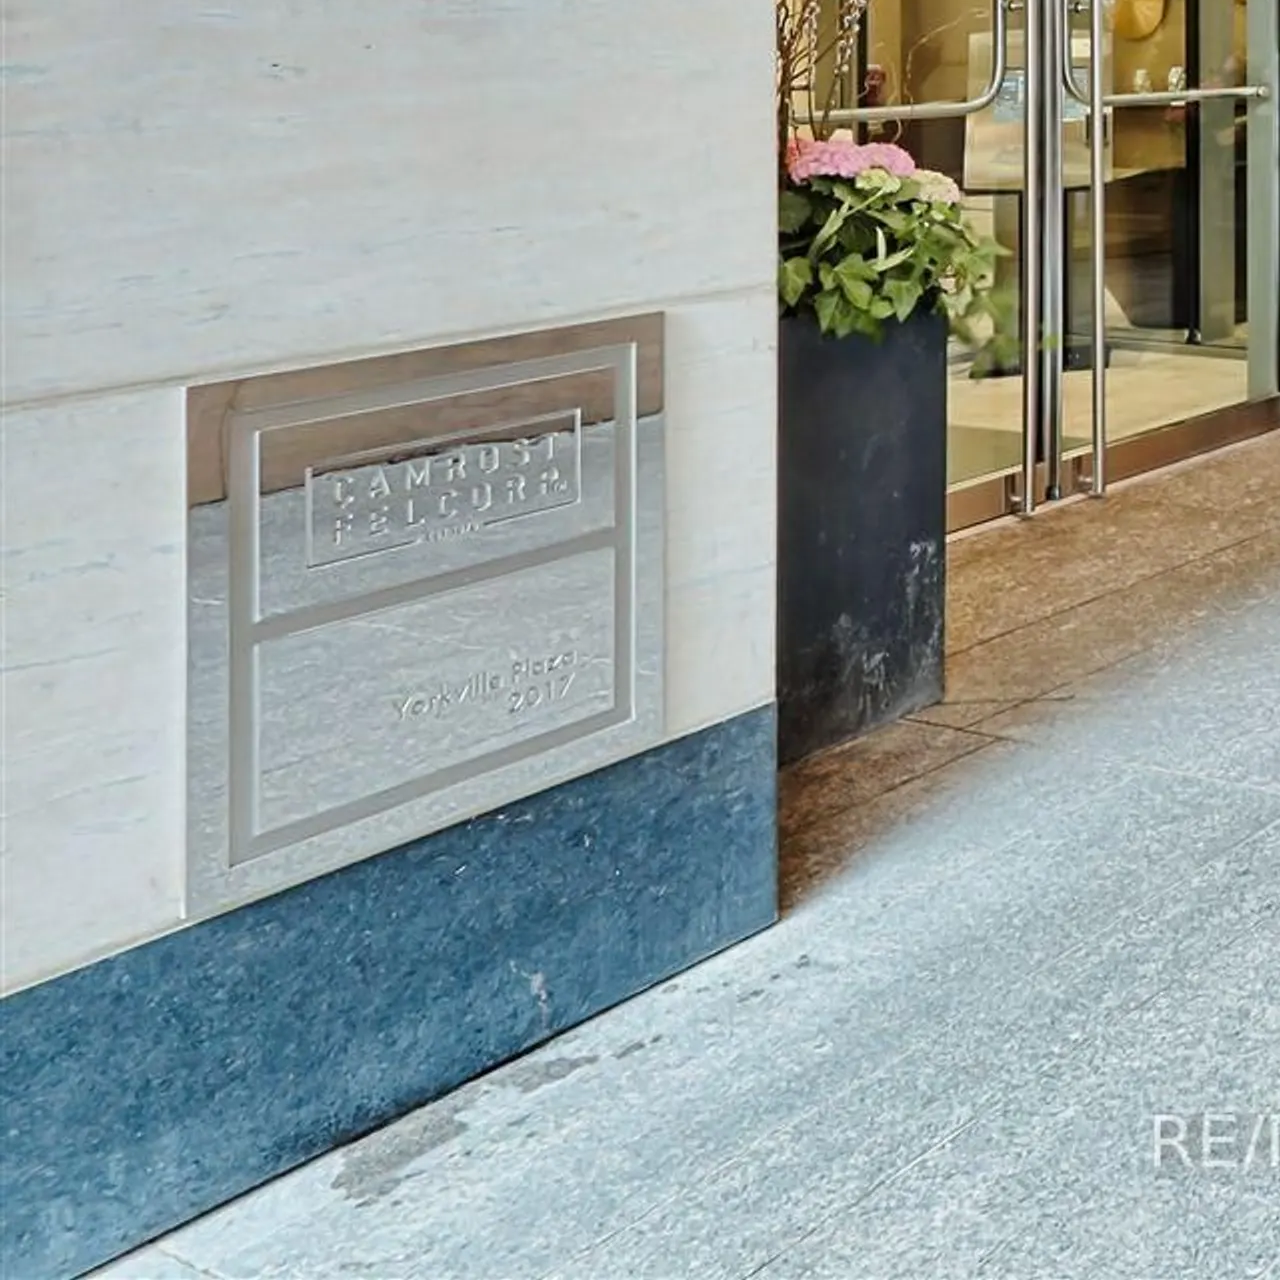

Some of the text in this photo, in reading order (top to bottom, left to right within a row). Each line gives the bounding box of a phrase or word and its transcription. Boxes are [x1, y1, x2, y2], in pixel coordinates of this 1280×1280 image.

[333, 432, 561, 509] CAMROST
[334, 467, 560, 546] FELCORP
[394, 650, 578, 720] Yorkville Plaza
[509, 672, 576, 714] 2017
